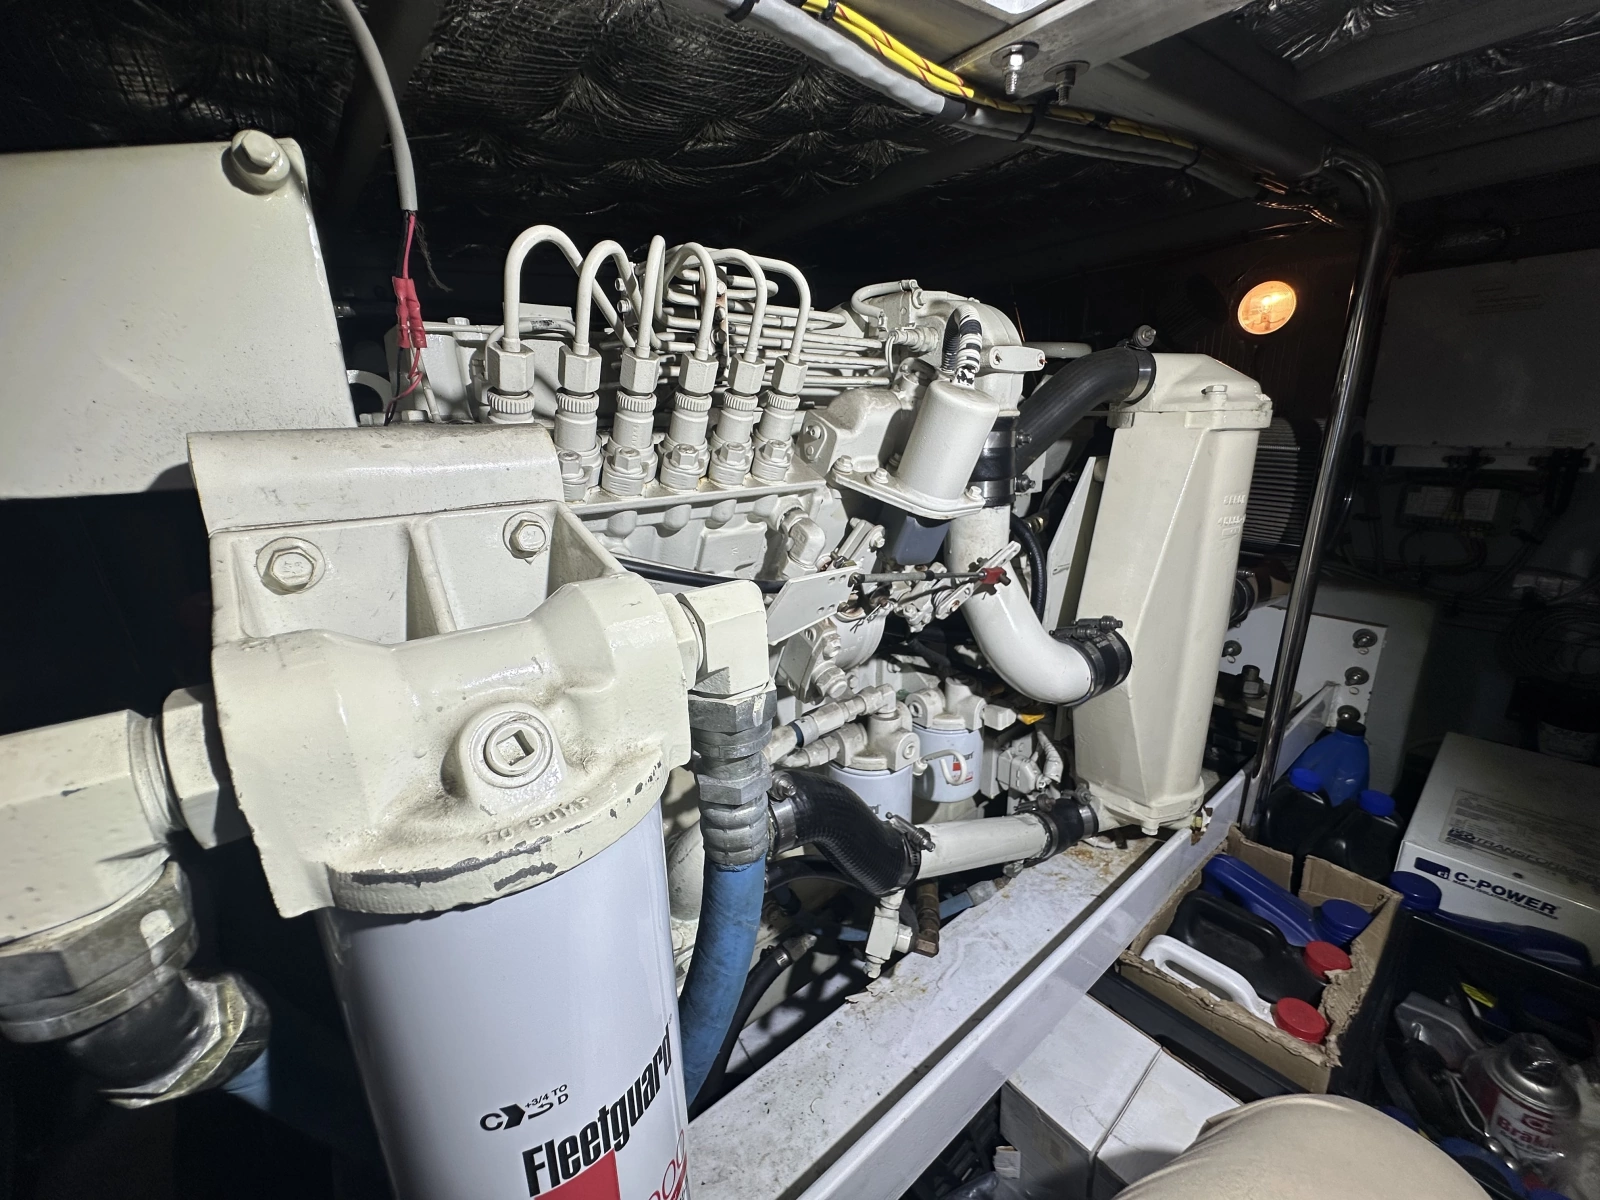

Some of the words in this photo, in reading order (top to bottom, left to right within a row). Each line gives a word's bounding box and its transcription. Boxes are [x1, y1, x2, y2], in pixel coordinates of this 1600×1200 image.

[1454, 872, 1558, 915] C-POWER
[551, 1084, 568, 1096] TO
[480, 1112, 503, 1131] C
[522, 1023, 672, 1198] Fleetguard
